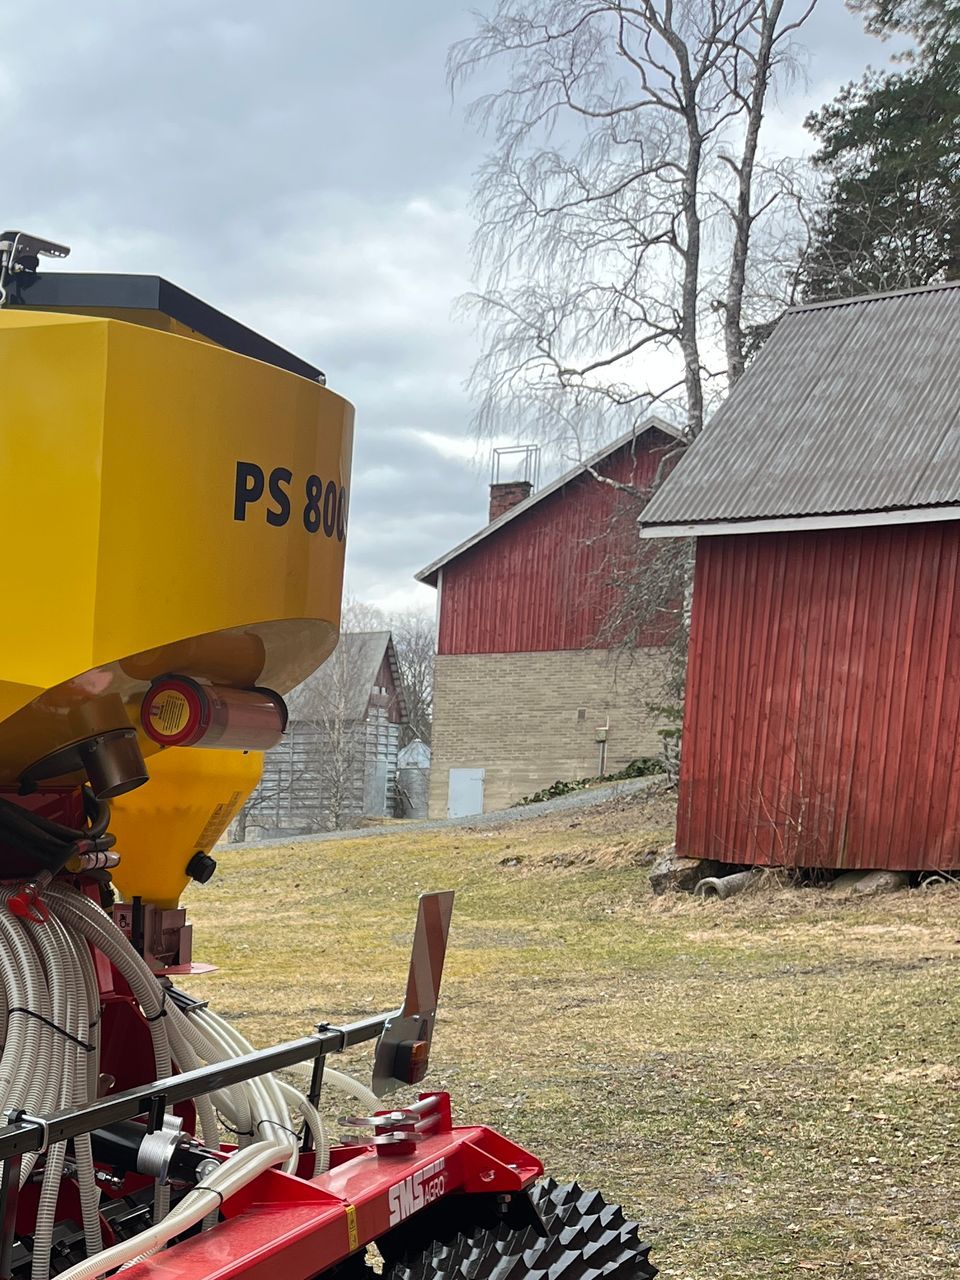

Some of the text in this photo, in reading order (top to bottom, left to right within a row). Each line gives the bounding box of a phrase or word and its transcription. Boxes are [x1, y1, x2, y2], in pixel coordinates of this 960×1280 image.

[234, 461, 292, 527] PS
[388, 1170, 444, 1228] SMS AGRO
